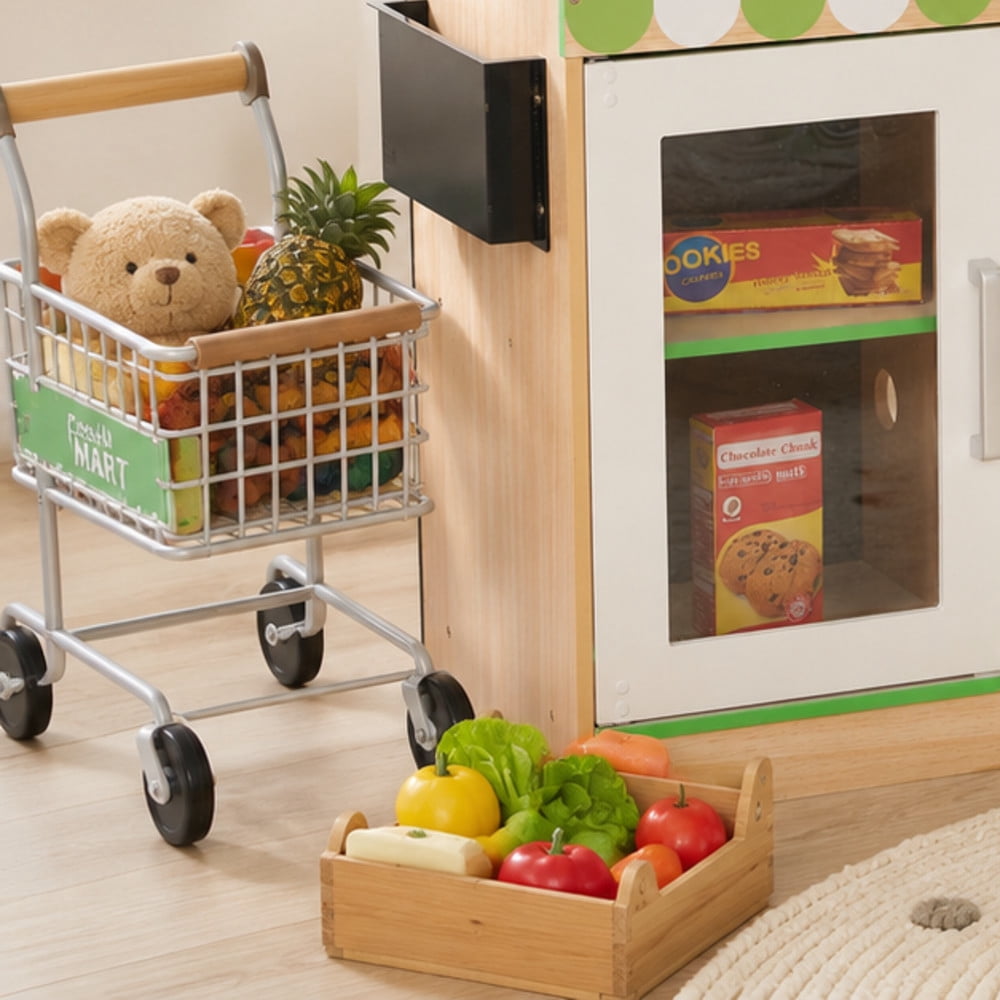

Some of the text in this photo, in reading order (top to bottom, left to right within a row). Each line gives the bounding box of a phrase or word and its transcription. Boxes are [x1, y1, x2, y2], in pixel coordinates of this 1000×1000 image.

[664, 241, 761, 276] OOKIES
[74, 438, 129, 490] MART
[720, 447, 777, 463] Chocolate
